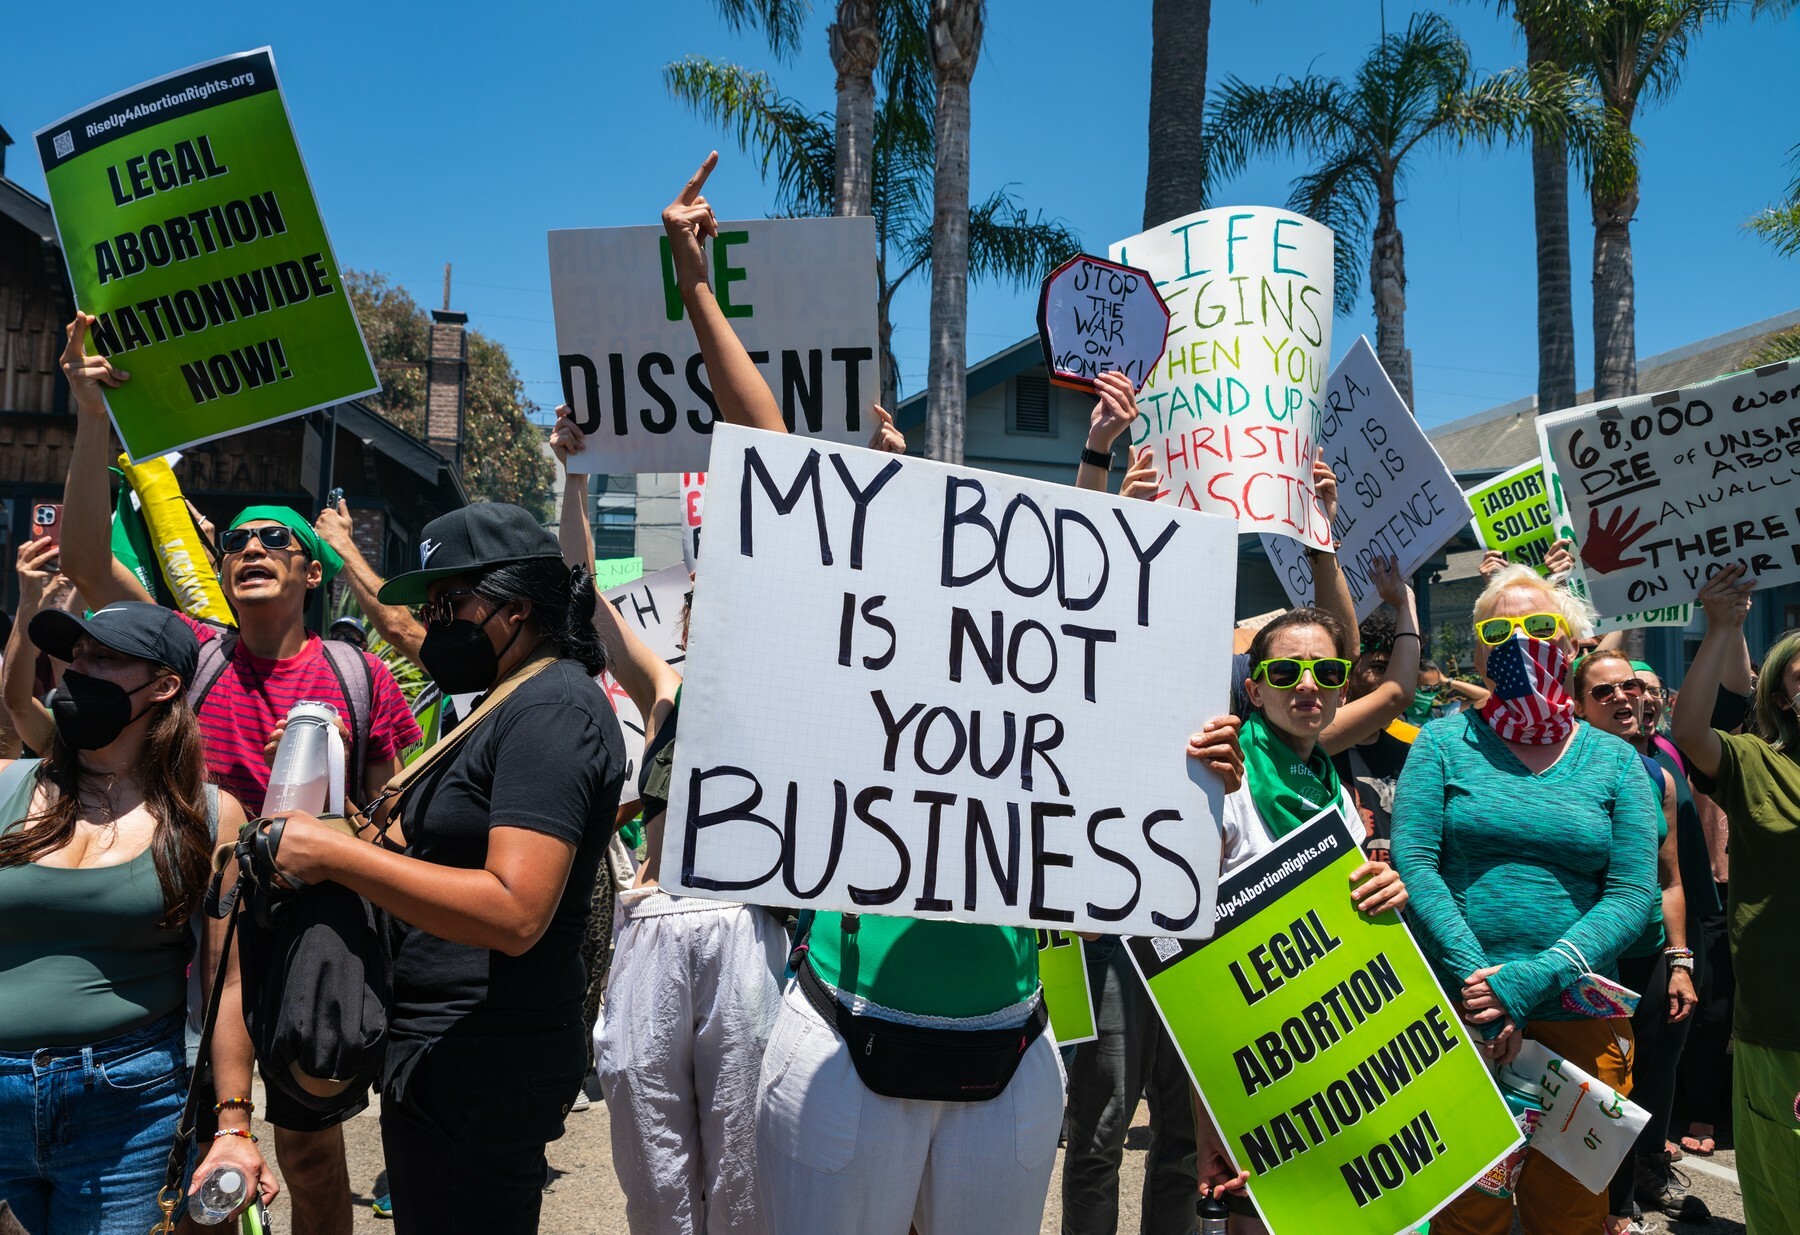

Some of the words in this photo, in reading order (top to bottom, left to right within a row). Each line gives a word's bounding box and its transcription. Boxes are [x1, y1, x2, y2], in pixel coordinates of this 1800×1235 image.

[86, 72, 255, 138] RiseUp4AbortionRights.org
[107, 135, 229, 207] LEGAL
[94, 191, 288, 286] ABORTION
[90, 253, 335, 358] NATIONWIDE
[1074, 261, 1138, 302] STOP
[1087, 295, 1124, 319] THE
[1164, 276, 1322, 347] EGINS
[1074, 306, 1124, 346] WAR
[1085, 340, 1111, 357] ON
[181, 338, 293, 404] NOW!
[559, 347, 873, 436] DISSNT
[1262, 336, 1321, 394] YOU
[1265, 385, 1302, 424] UP
[1308, 399, 1321, 444] TO
[1360, 418, 1387, 453] IS
[1568, 400, 1713, 469] 68,000
[1355, 472, 1382, 508] SO
[1379, 448, 1405, 481] IS
[1581, 452, 1657, 495] DIE
[611, 561, 641, 576] NOT
[740, 446, 903, 570] MY
[941, 475, 1181, 627] BODY
[1639, 515, 1789, 569] THERE
[1628, 575, 1668, 602] ON
[838, 592, 897, 671] IS
[949, 606, 1116, 703] NOT
[870, 689, 1070, 796] YOUR
[682, 765, 1201, 932] BUSINESS
[1214, 834, 1338, 922] eUp4AbortionRights.org
[1228, 908, 1342, 1007] LEGAL
[1232, 952, 1406, 1097] ABORTION
[1239, 1004, 1460, 1177] NATIONWIDE
[1339, 1109, 1447, 1208] NOW!
